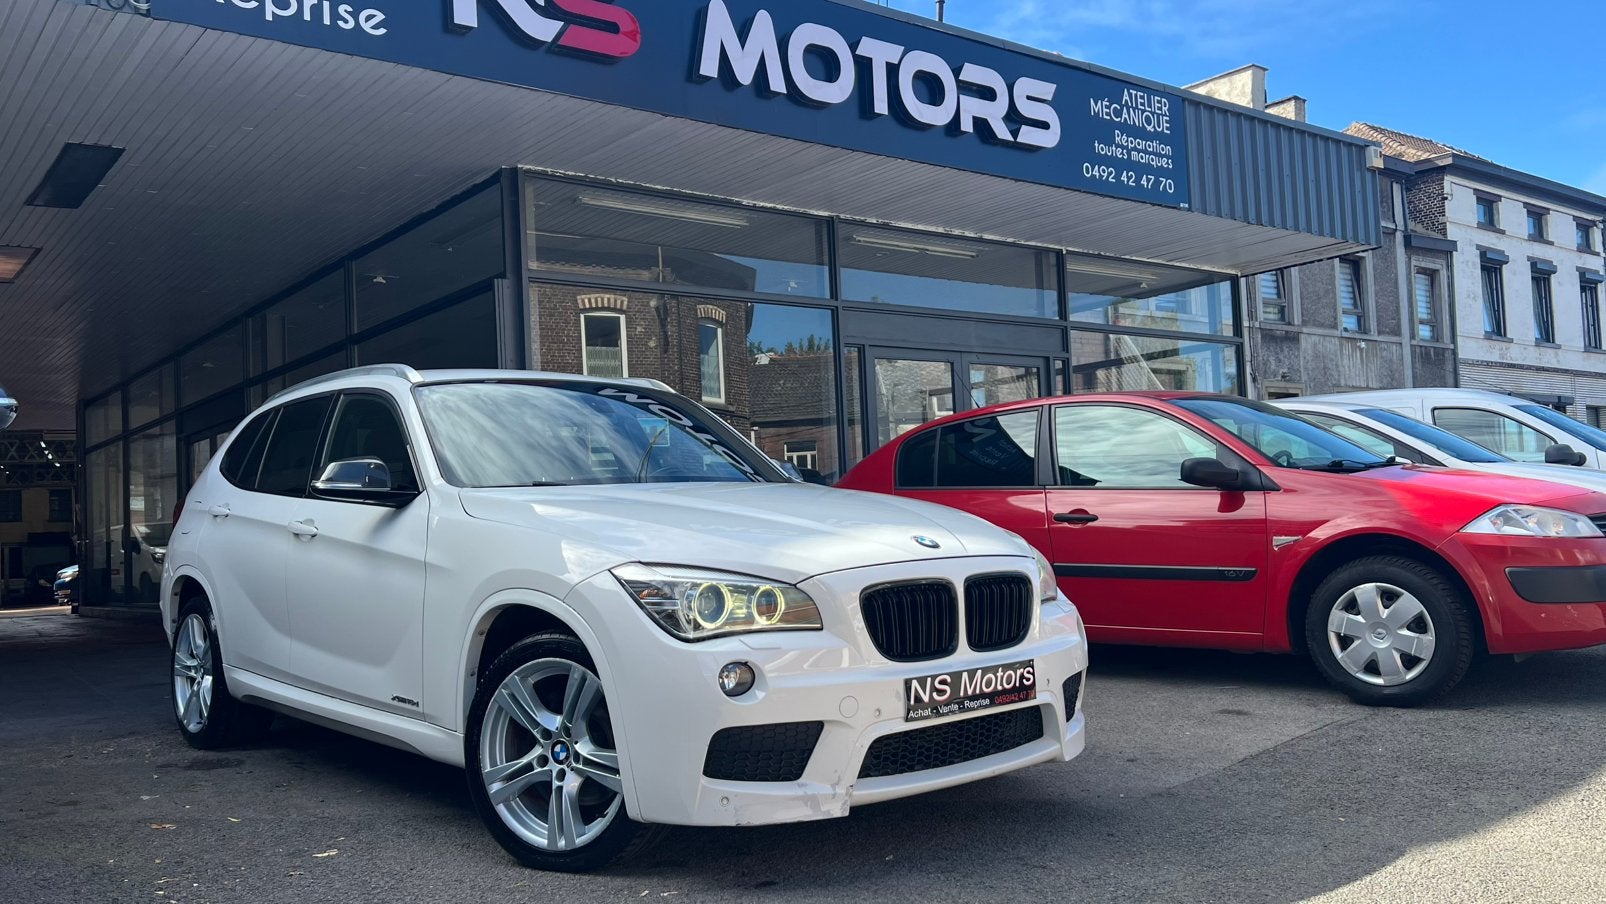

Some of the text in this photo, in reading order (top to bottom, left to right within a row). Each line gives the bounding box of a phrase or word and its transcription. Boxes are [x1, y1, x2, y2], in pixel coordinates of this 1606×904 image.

[216, 0, 388, 36] prise
[699, 0, 1062, 148] MOTORS
[1090, 97, 1171, 134] MÉCANIQUE
[1122, 88, 1170, 116] ATELIER
[1094, 140, 1173, 169] toutes marques
[1114, 129, 1172, 156] Réparation
[1083, 162, 1175, 193] 0492 42 47 70
[910, 666, 1034, 706] NS Motors
[908, 708, 932, 719] Achat
[937, 703, 959, 714] Vente
[964, 697, 990, 710] Reprise
